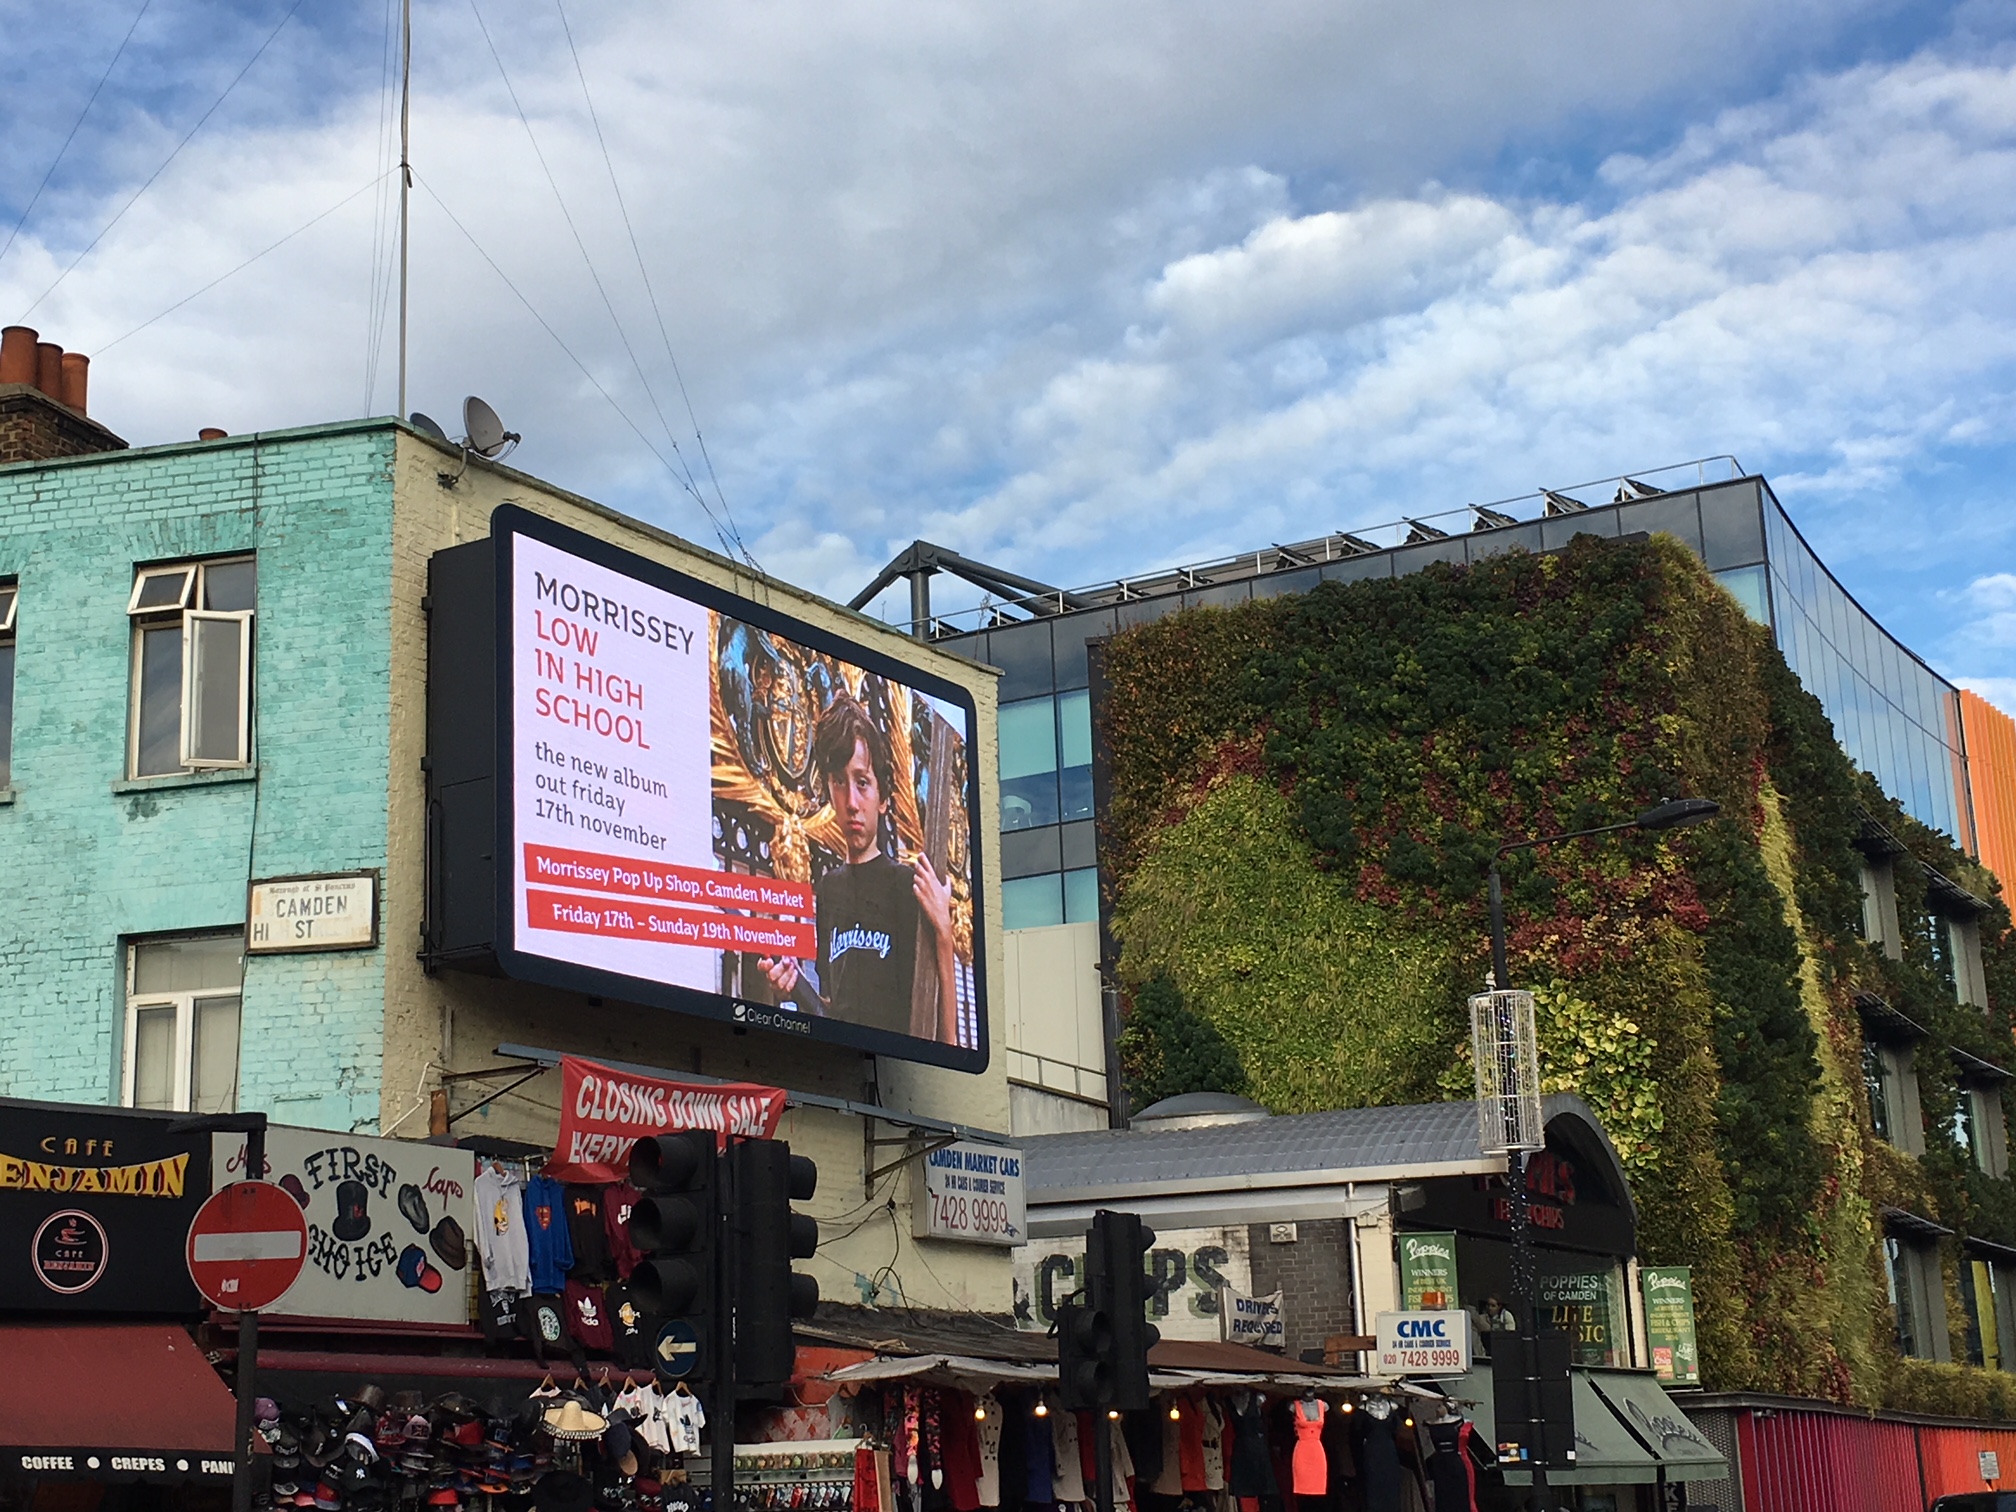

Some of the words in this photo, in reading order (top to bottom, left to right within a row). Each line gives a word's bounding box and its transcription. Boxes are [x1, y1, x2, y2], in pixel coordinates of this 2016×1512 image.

[535, 571, 694, 655] MORRISSEY
[535, 609, 598, 657] LOW
[535, 648, 564, 684] IN
[574, 662, 643, 710] HIGH
[536, 688, 650, 750] SCHOOL
[535, 741, 565, 767] the
[571, 756, 608, 780] new
[613, 767, 668, 799] album
[536, 774, 567, 796] out
[572, 780, 625, 817] friday
[536, 798, 574, 826] 17th
[580, 814, 667, 850] november
[537, 856, 609, 886] Morrissey
[612, 867, 640, 890] Pop
[643, 871, 663, 893] Up
[666, 875, 704, 898] Shop,
[706, 880, 758, 902] Camden
[760, 888, 804, 908] Market
[276, 896, 348, 918] CAMDEN
[552, 904, 601, 929] Friday
[604, 910, 634, 929] 17th
[648, 915, 699, 940] Sunday
[702, 922, 731, 940] 19th
[733, 925, 796, 947] November
[295, 920, 315, 939] ST
[747, 1008, 772, 1027] Clear
[773, 1013, 811, 1034] Channel
[576, 1075, 667, 1128] CLOSING
[668, 1090, 725, 1134] DOWN
[727, 1096, 772, 1137] SALE
[40, 1136, 114, 1157] CAFE
[568, 1130, 639, 1166] EVERY
[929, 1149, 962, 1170] CAMDEN
[965, 1152, 998, 1175] MARKET
[1000, 1156, 1020, 1177] CARS
[0, 1153, 190, 1198] ENJAMIN
[304, 1147, 396, 1199] FIRST
[422, 1167, 464, 1211] Caps
[931, 1193, 968, 1230] 7428
[972, 1198, 1008, 1234] 9999
[309, 1224, 399, 1282] CHOICE
[1406, 1238, 1450, 1260] Poppies
[1410, 1268, 1448, 1276] WINNERS
[1540, 1275, 1598, 1289] POPPIES
[1648, 1272, 1687, 1291] Poppies
[1543, 1291, 1556, 1300] OF
[1558, 1291, 1597, 1300] CAMDEN
[1551, 1305, 1593, 1323] LIE
[1397, 1319, 1446, 1338] CMC
[1383, 1353, 1397, 1365] 020
[1401, 1350, 1428, 1367] 7428
[1432, 1349, 1459, 1366] 9999
[21, 1456, 74, 1470] COFFEE
[111, 1457, 166, 1471] CREPES
[201, 1460, 236, 1474] PANI
